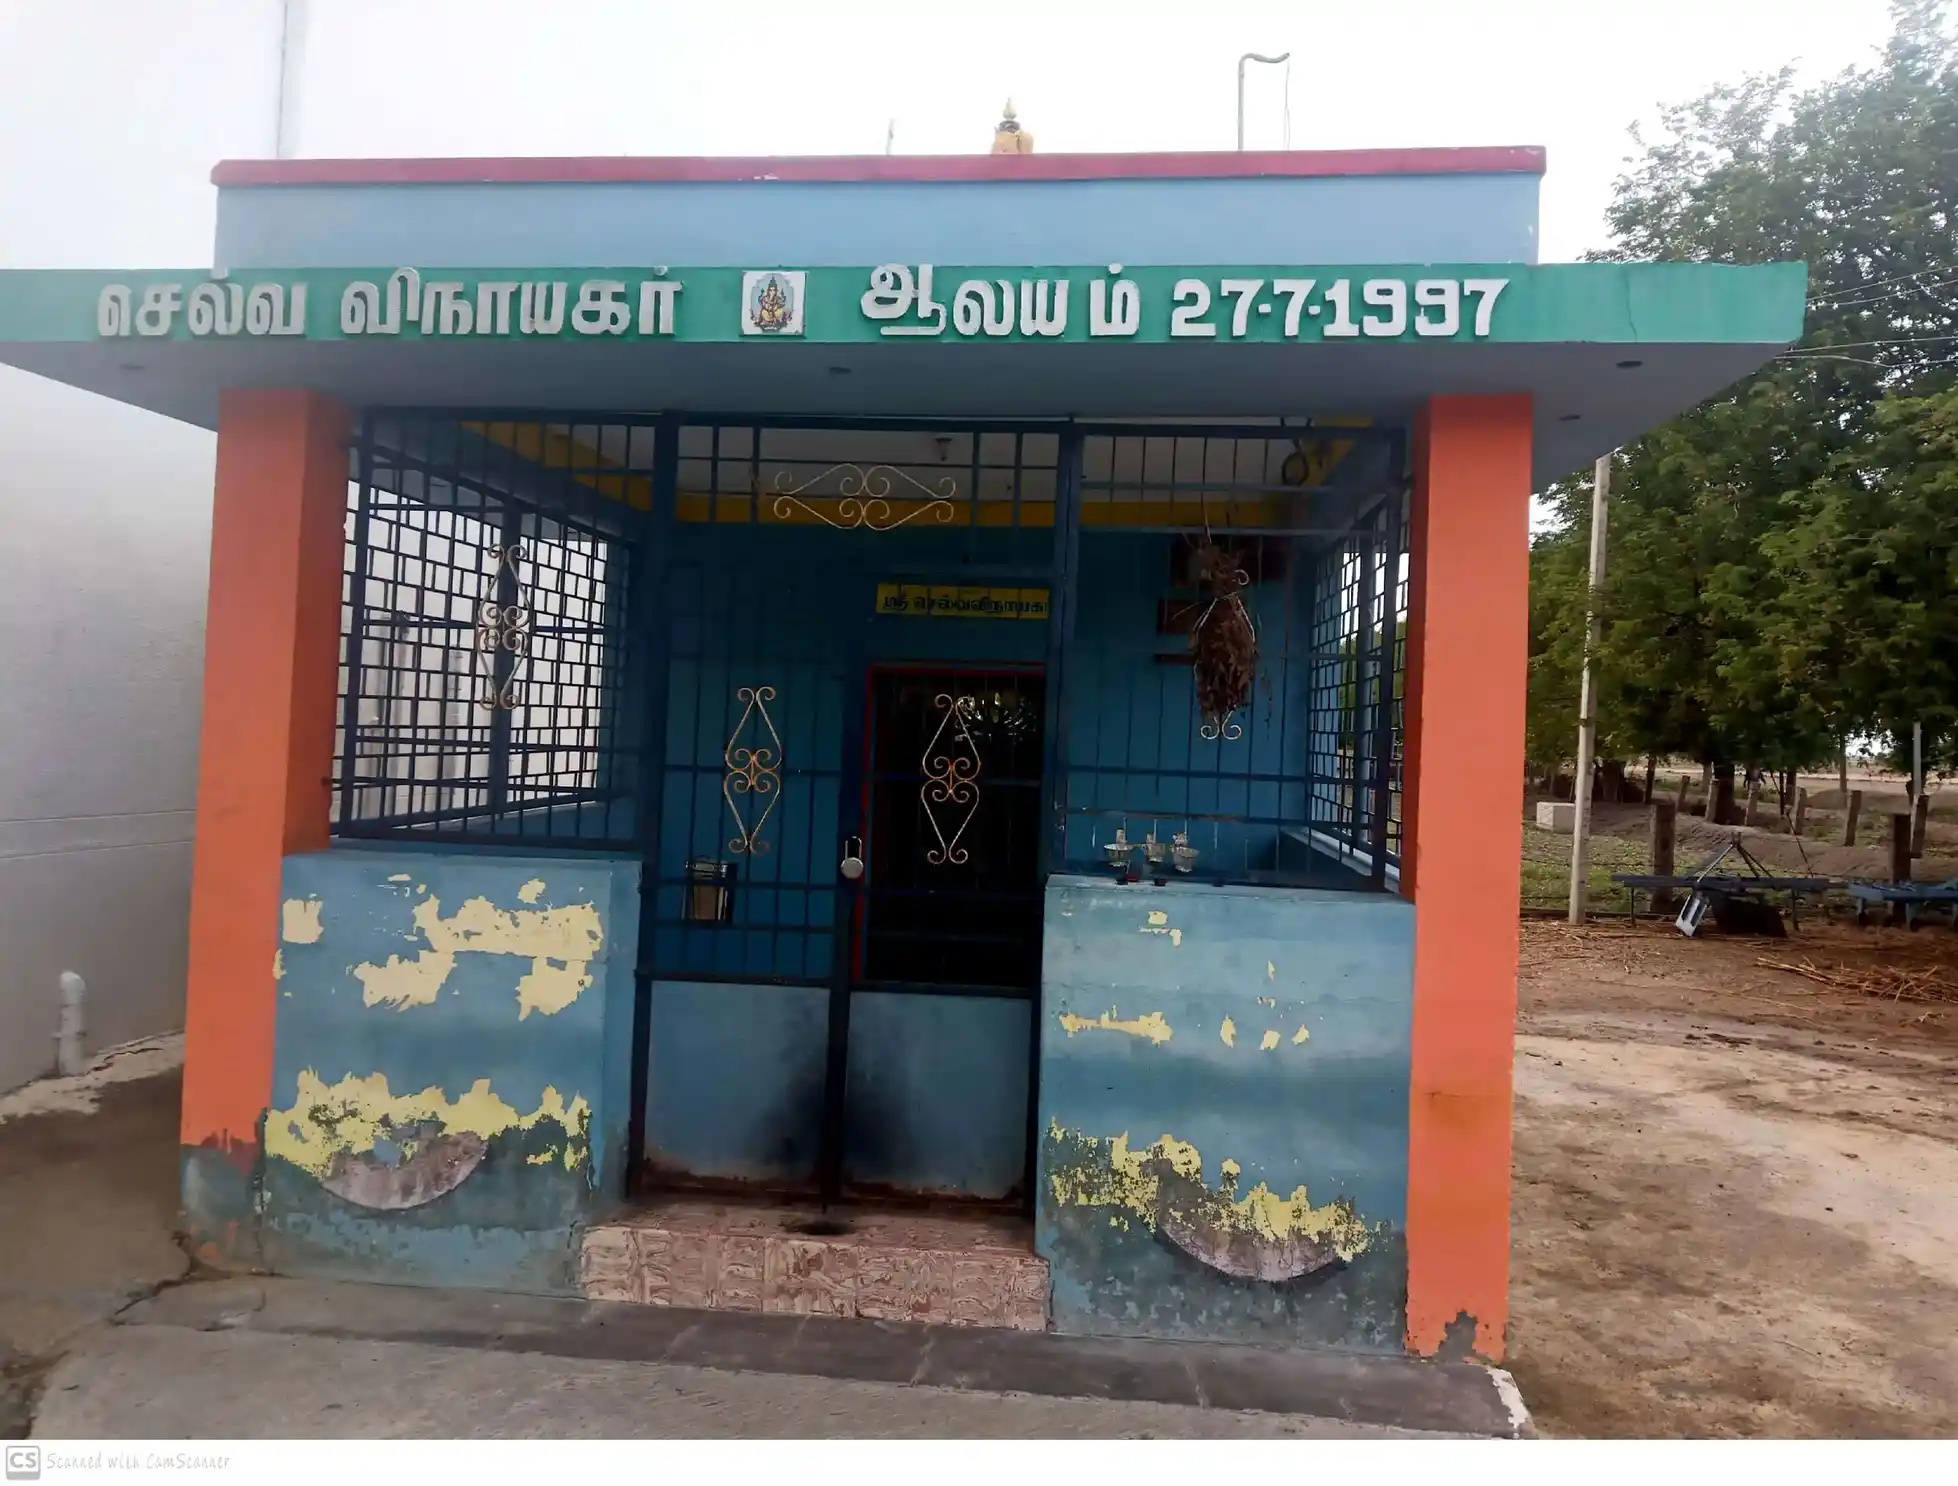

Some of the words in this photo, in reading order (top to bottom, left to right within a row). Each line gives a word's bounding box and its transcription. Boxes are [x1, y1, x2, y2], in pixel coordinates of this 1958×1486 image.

[98, 266, 307, 337] செல்வ
[340, 265, 684, 336] விநாயகர்
[860, 262, 1141, 337] ஆலயம்
